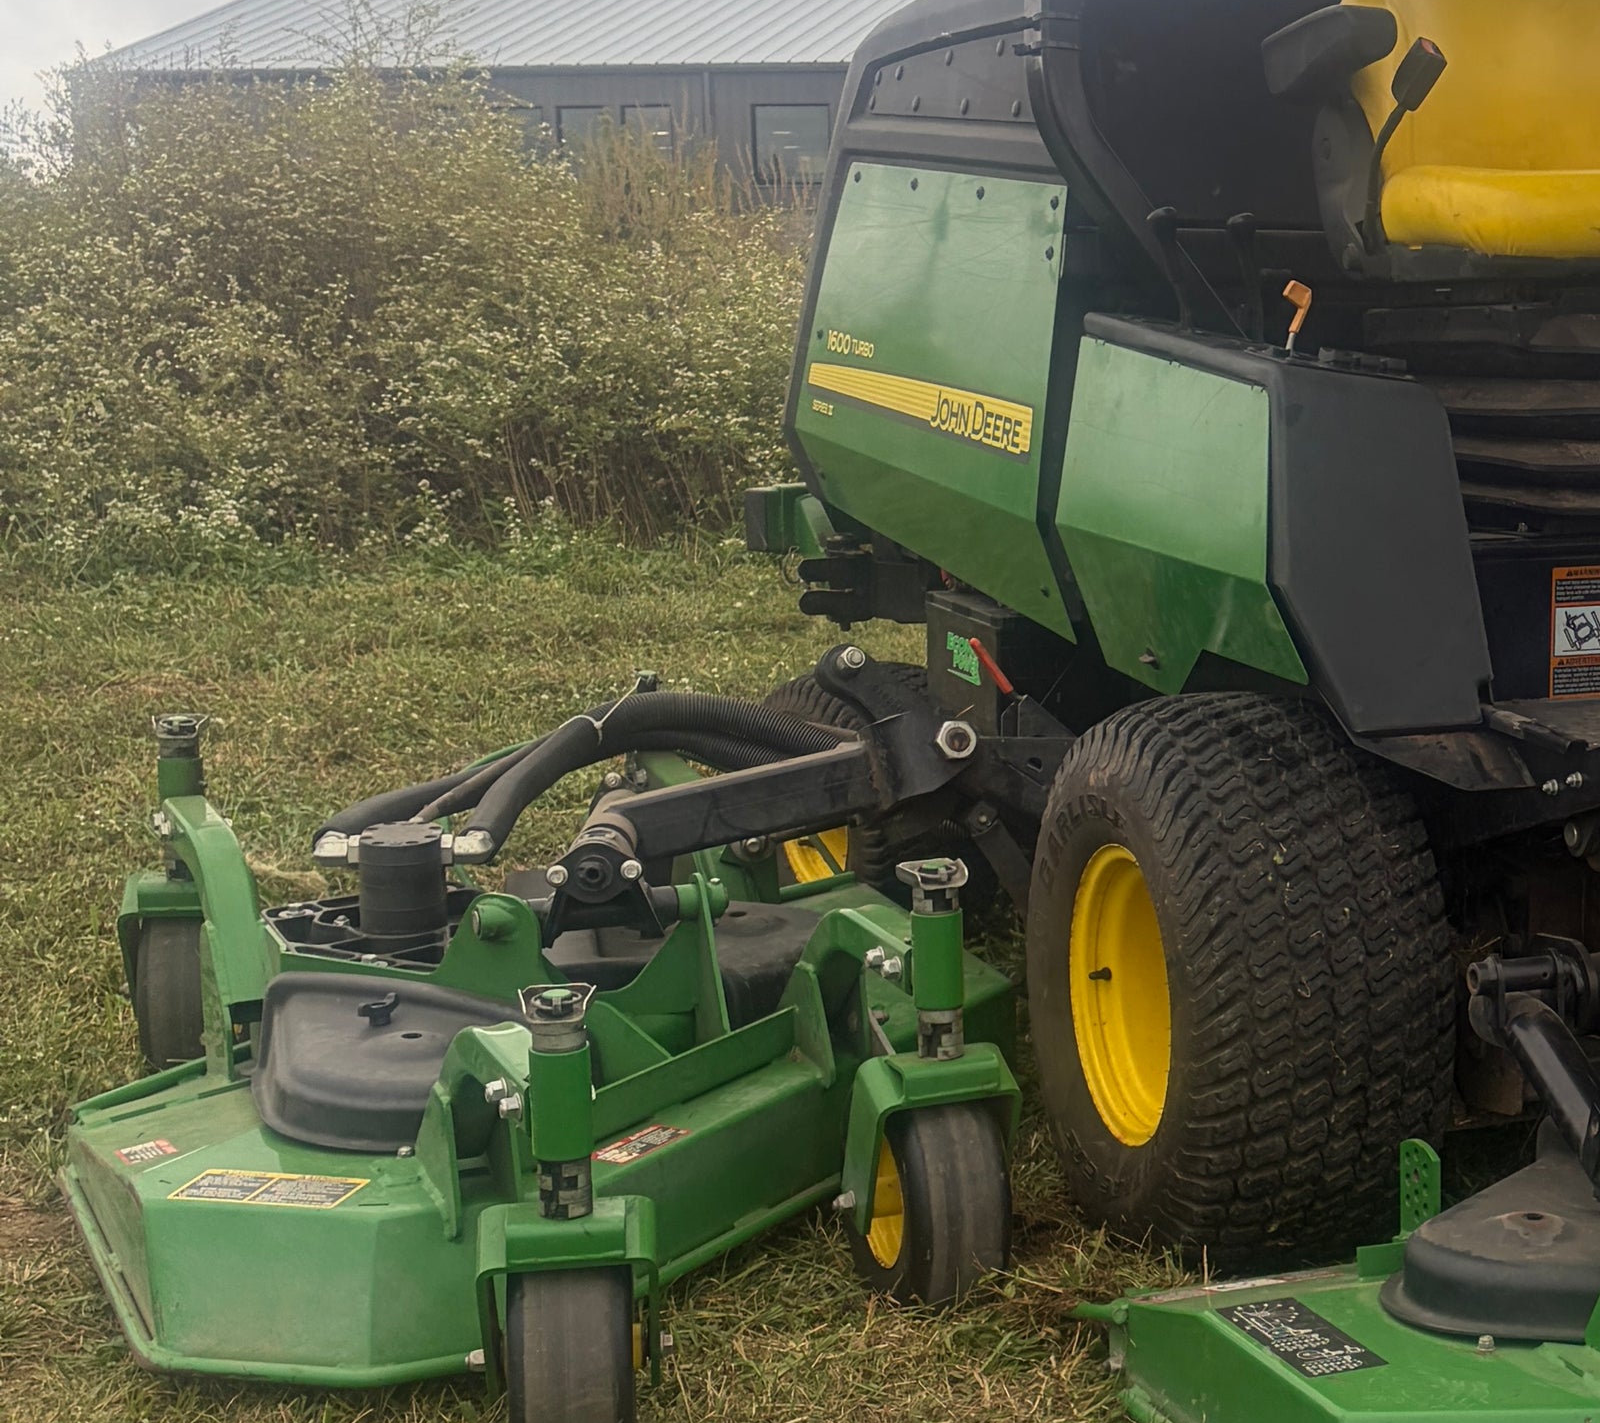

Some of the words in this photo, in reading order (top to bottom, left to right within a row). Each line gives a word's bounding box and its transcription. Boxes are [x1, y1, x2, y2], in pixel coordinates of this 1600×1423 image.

[827, 329, 851, 355] 1600
[851, 338, 875, 358] TURBO
[931, 390, 971, 433] JOHN
[972, 401, 1023, 450] DEERE
